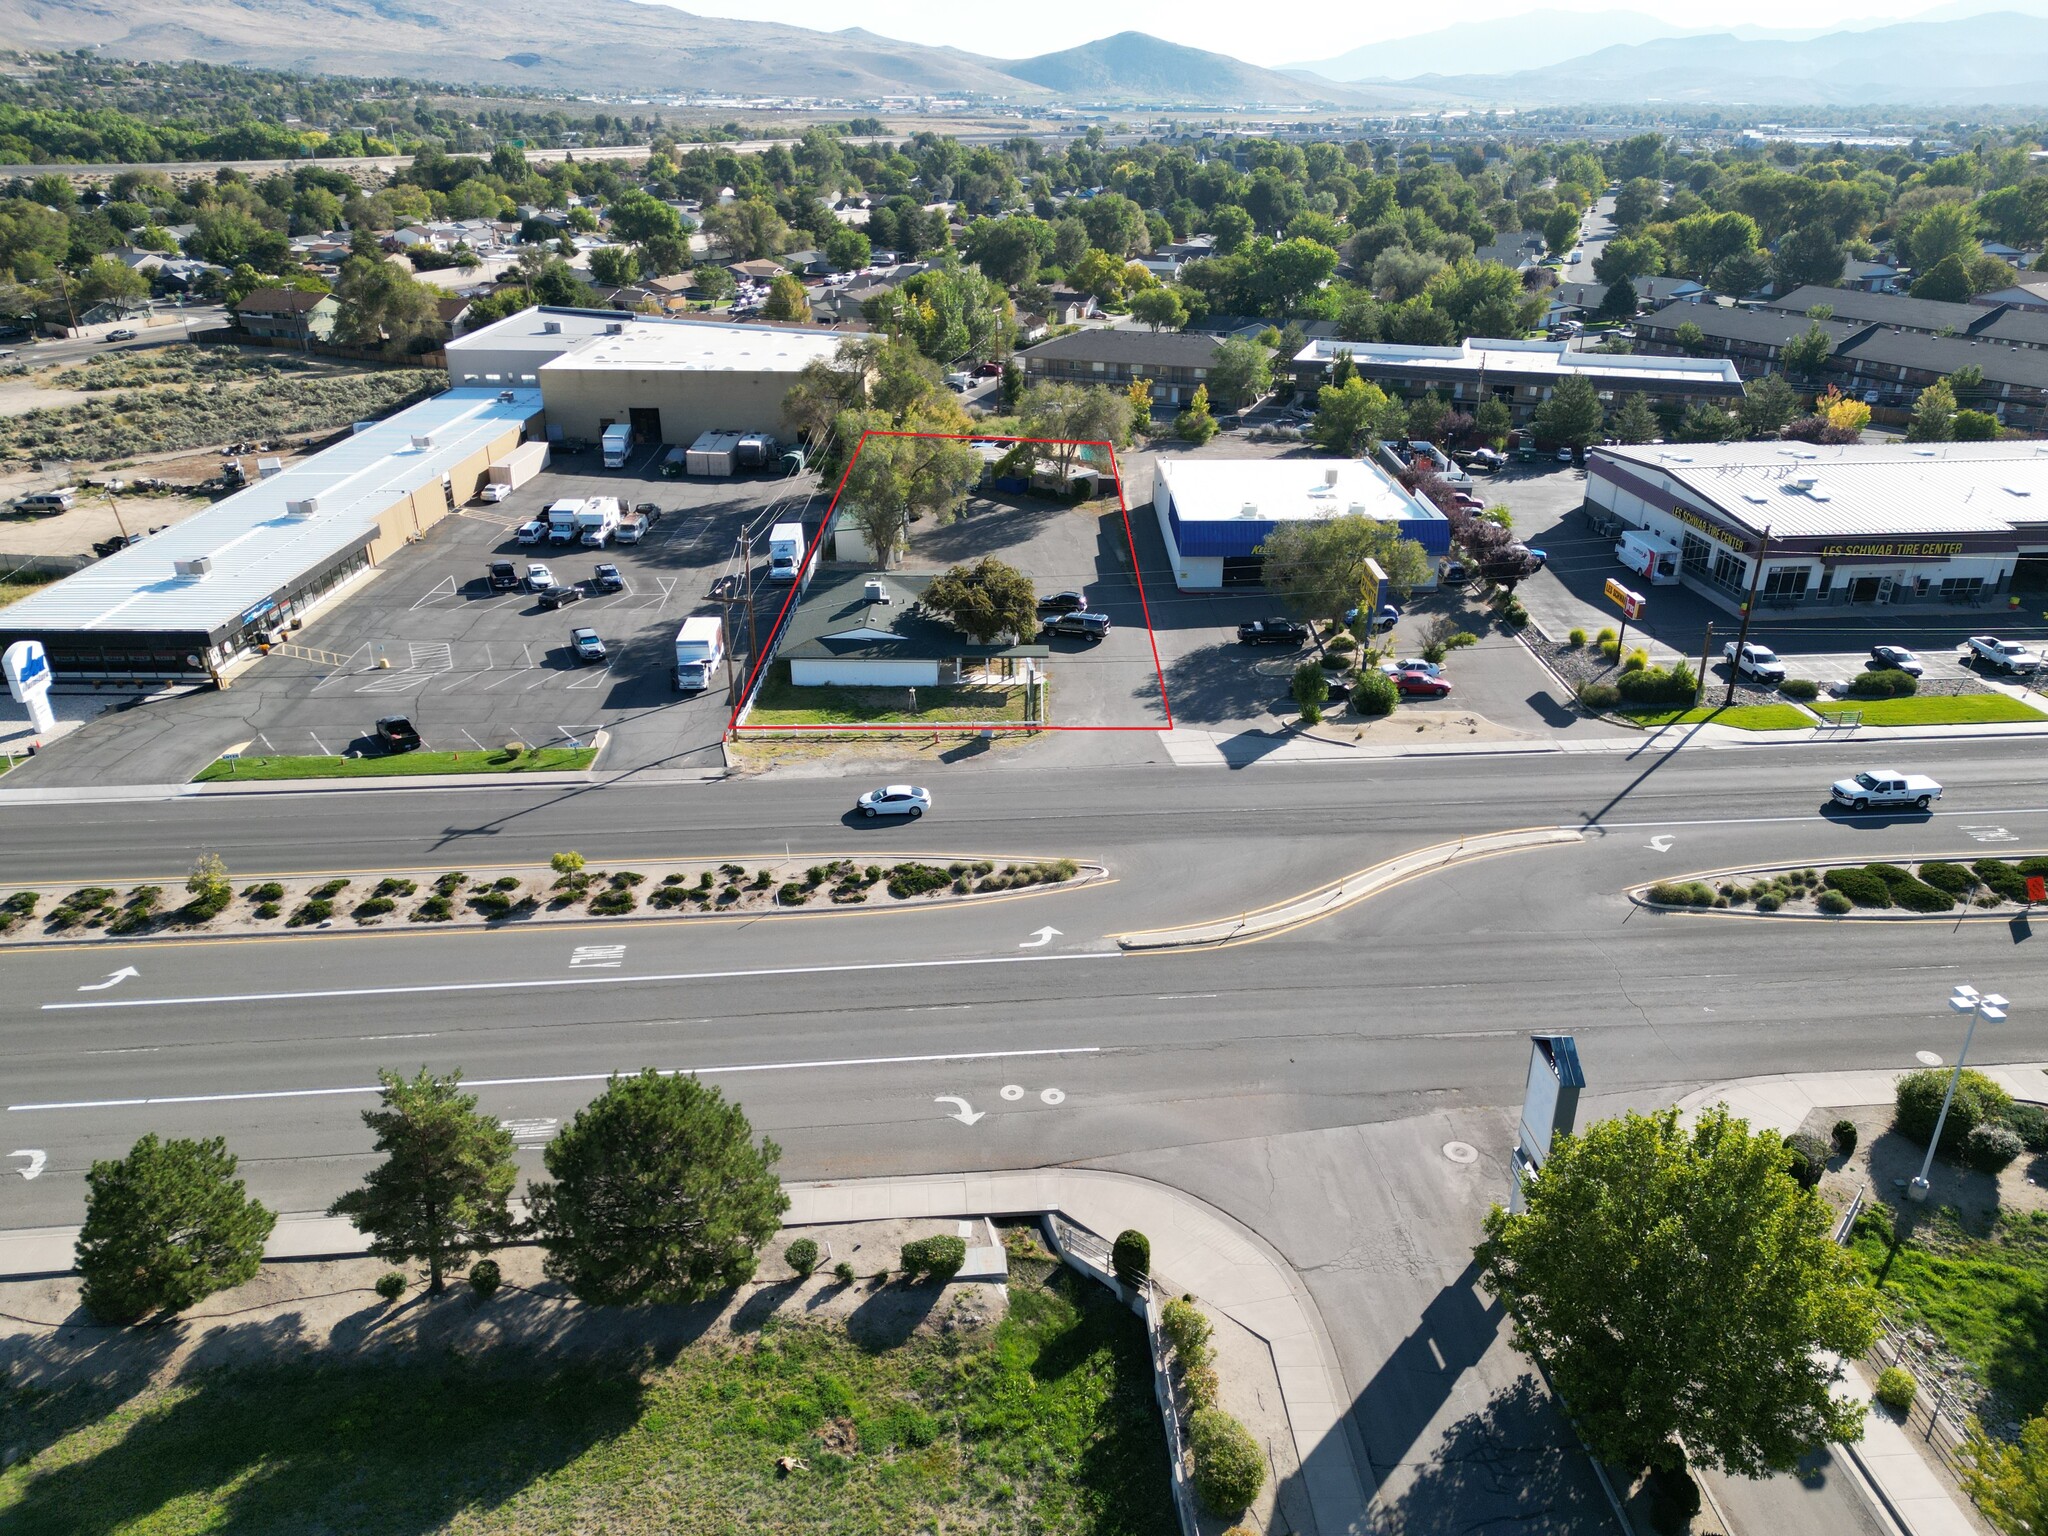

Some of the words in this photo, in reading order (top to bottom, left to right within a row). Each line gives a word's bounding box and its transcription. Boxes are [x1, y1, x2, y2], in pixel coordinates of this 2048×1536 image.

[1673, 506, 1683, 519] LES
[1683, 511, 1707, 532] SCHWAB
[1708, 524, 1720, 539] TIRE
[1721, 531, 1744, 551] CENTER
[1823, 546, 1843, 557] LES
[1845, 544, 1893, 556] SCHWAB
[1897, 543, 1920, 555] TIRE
[1922, 542, 1963, 555] CENTER
[1957, 825, 2019, 841] ONLY
[568, 944, 627, 968] ONLY
